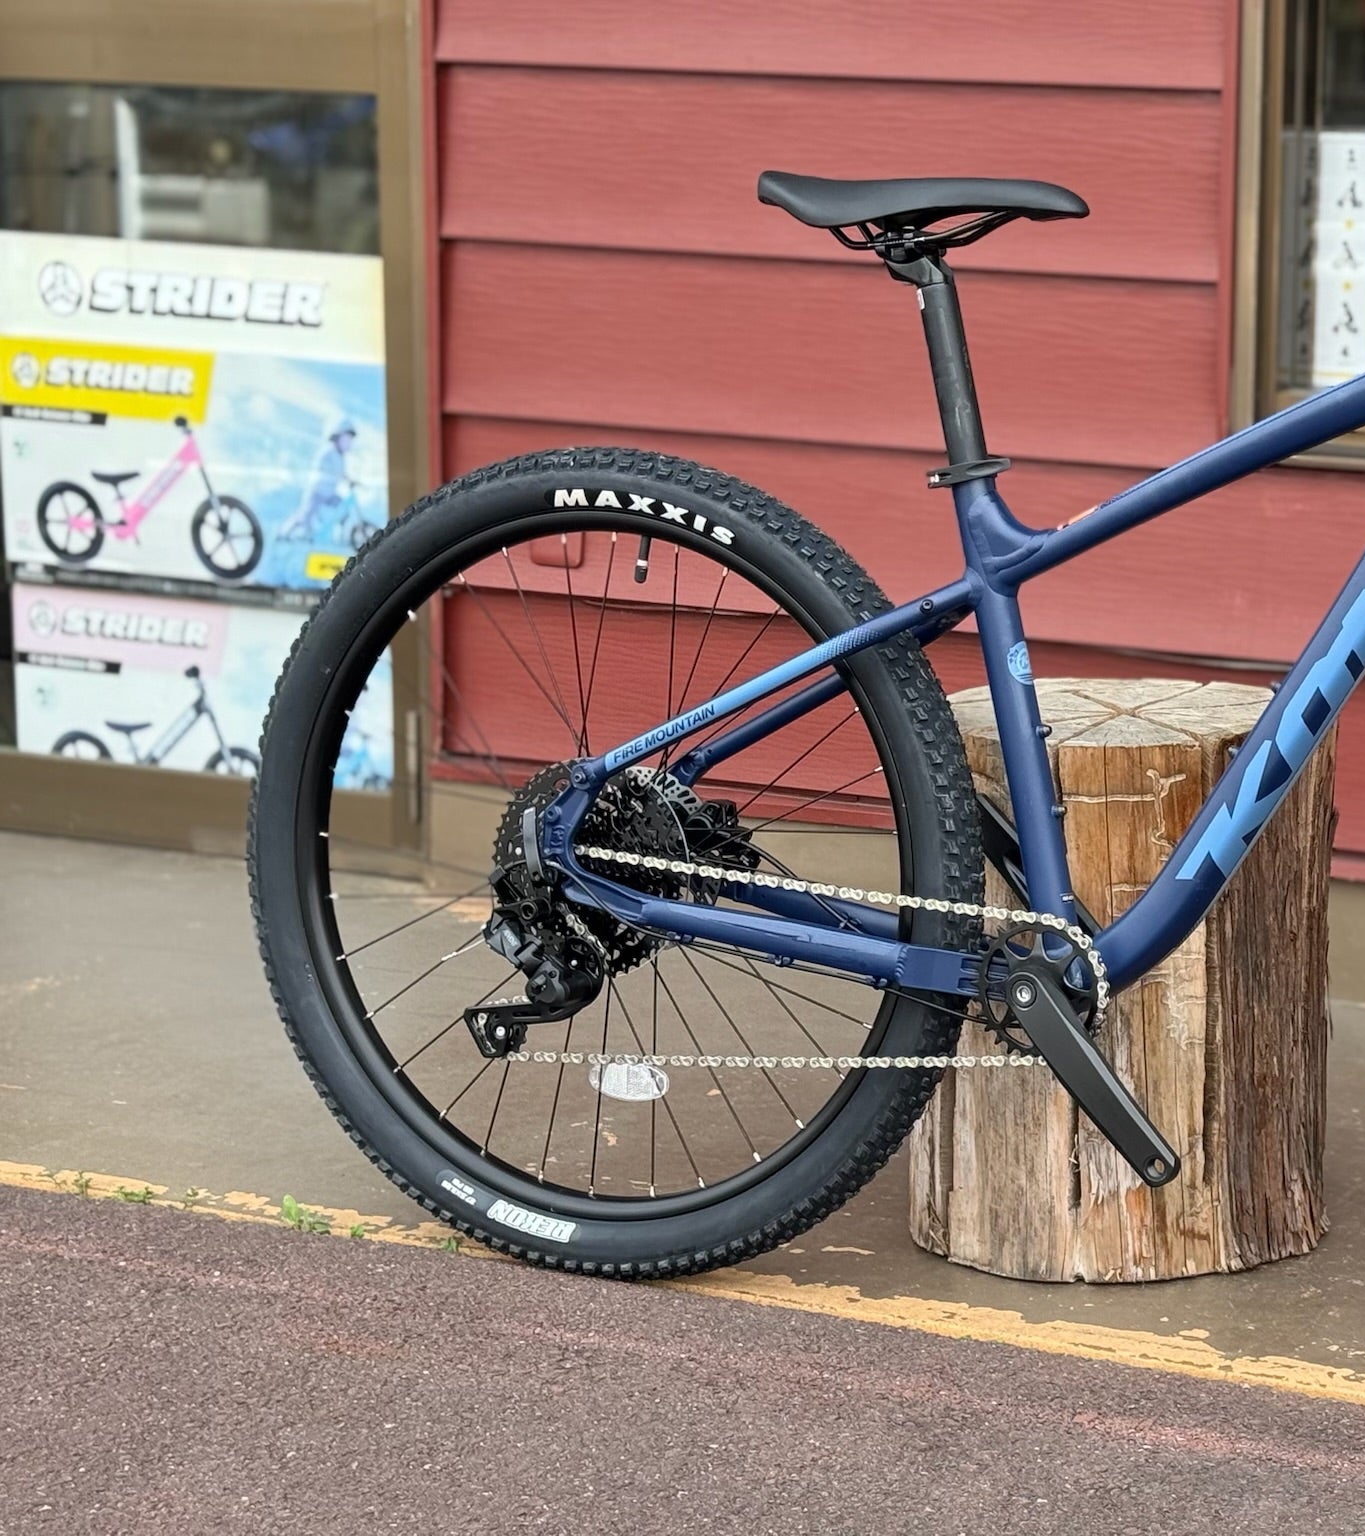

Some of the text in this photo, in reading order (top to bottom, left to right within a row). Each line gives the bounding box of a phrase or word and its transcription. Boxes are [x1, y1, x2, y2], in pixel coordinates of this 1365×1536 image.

[90, 268, 323, 327] STRIDER
[45, 357, 195, 397] STRIDER
[554, 488, 736, 545] MAXXIS
[61, 605, 208, 649] STRIDER
[613, 704, 715, 763] FIRE MOUNTAIN
[487, 1200, 576, 1243] REKON
